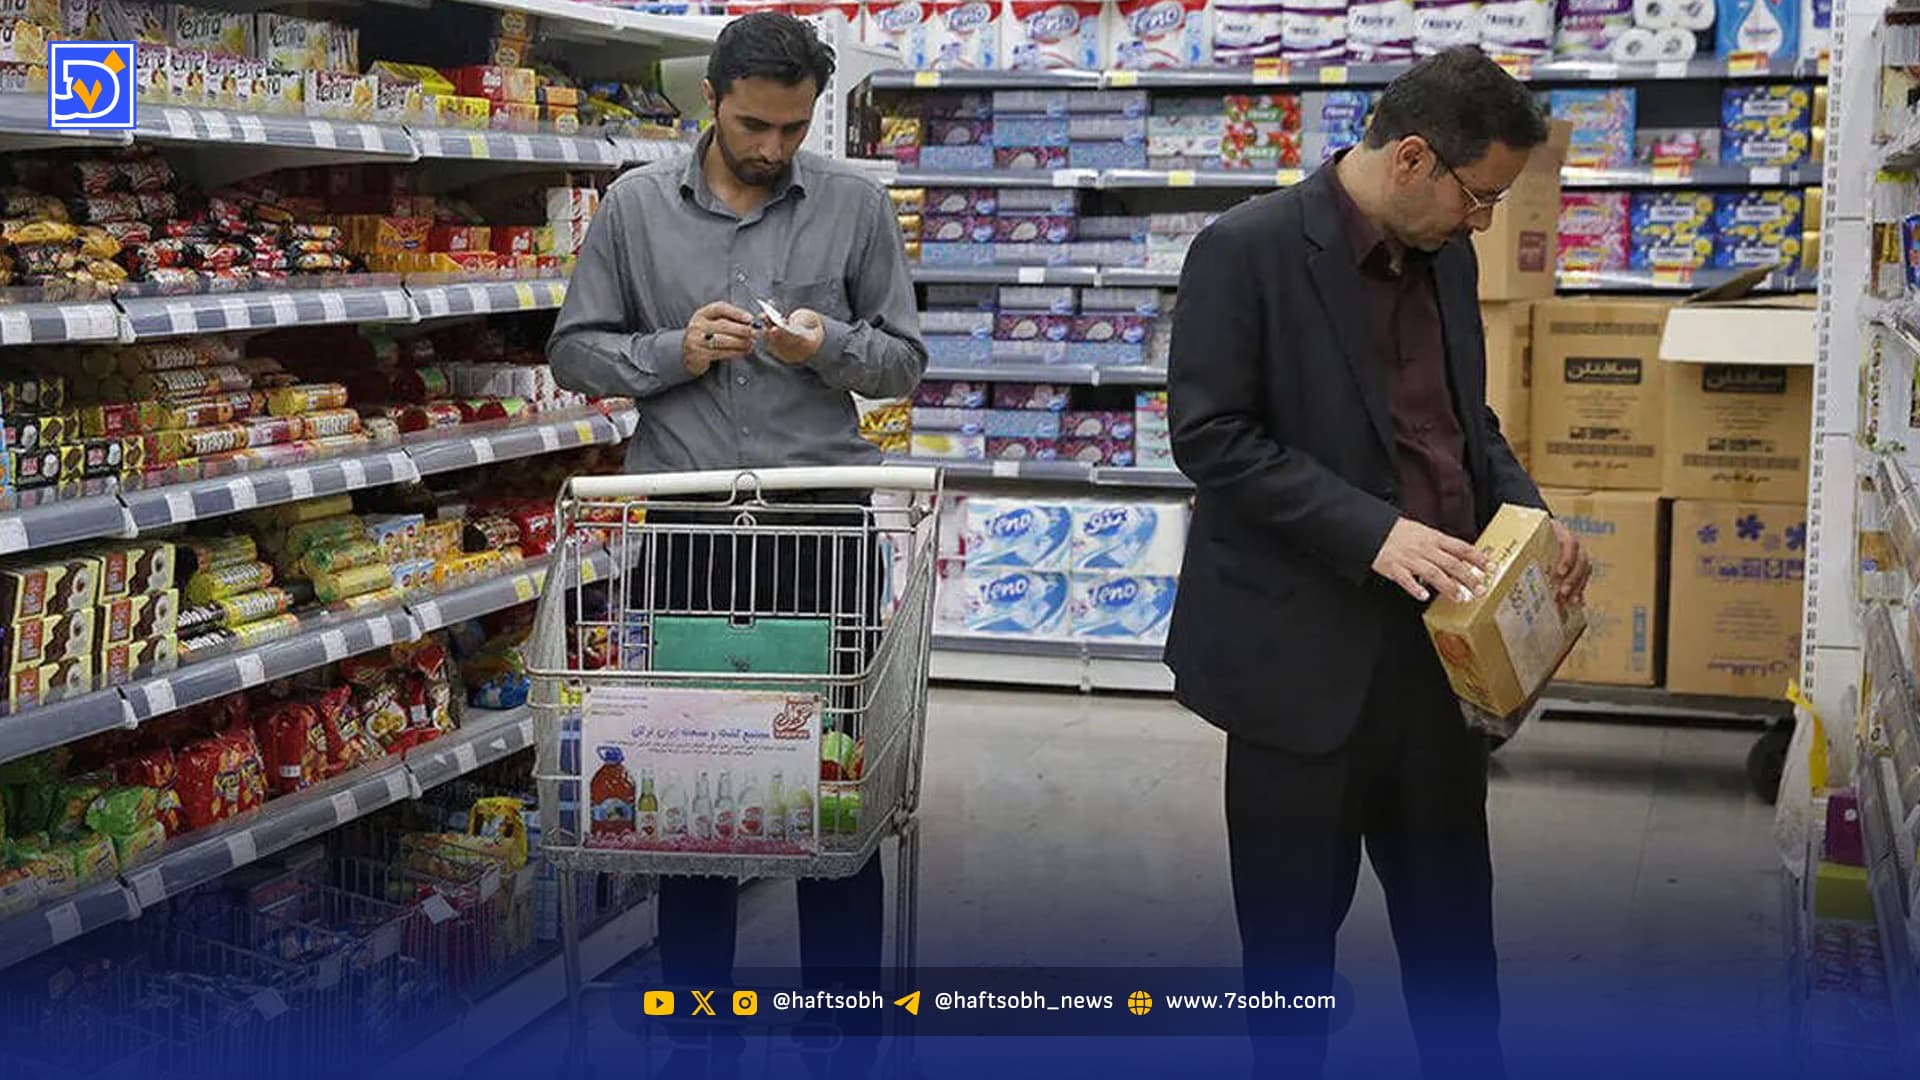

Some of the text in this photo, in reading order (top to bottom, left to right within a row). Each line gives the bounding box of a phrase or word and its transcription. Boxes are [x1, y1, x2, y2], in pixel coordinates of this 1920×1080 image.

[1024, 12, 1074, 38] Teno
[1128, 6, 1178, 35] Teno
[980, 576, 1029, 601] Teno
[1088, 581, 1137, 606] Teno
